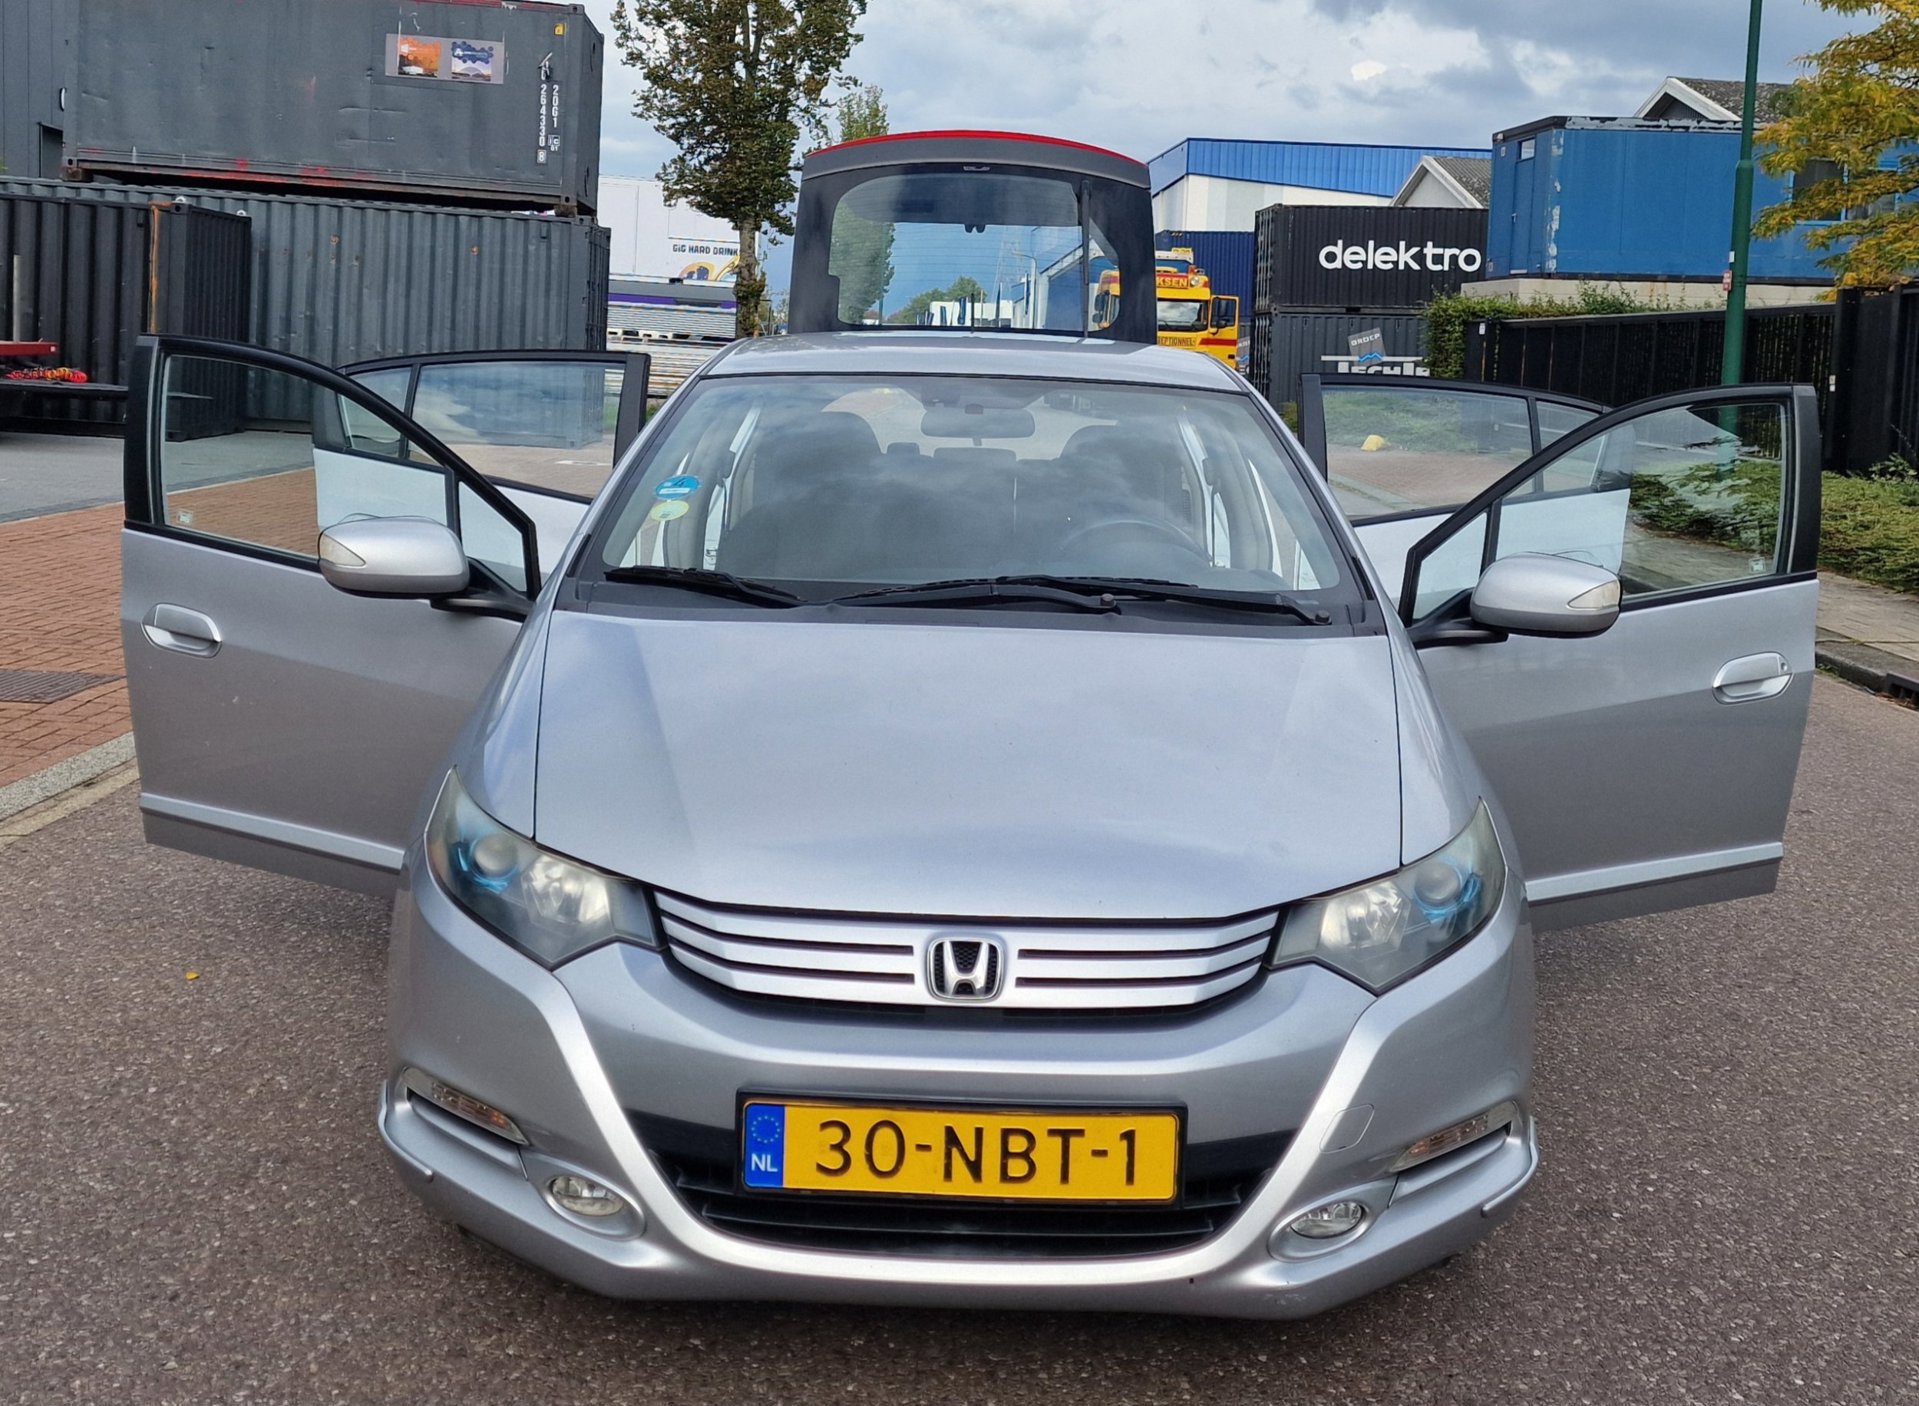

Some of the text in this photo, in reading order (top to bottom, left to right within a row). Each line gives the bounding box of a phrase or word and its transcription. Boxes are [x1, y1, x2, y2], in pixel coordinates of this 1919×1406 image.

[688, 245, 711, 255] HARD
[1319, 239, 1482, 273] delektro
[751, 1152, 778, 1173] NL
[815, 1120, 1138, 1187] 30-NBT-1
